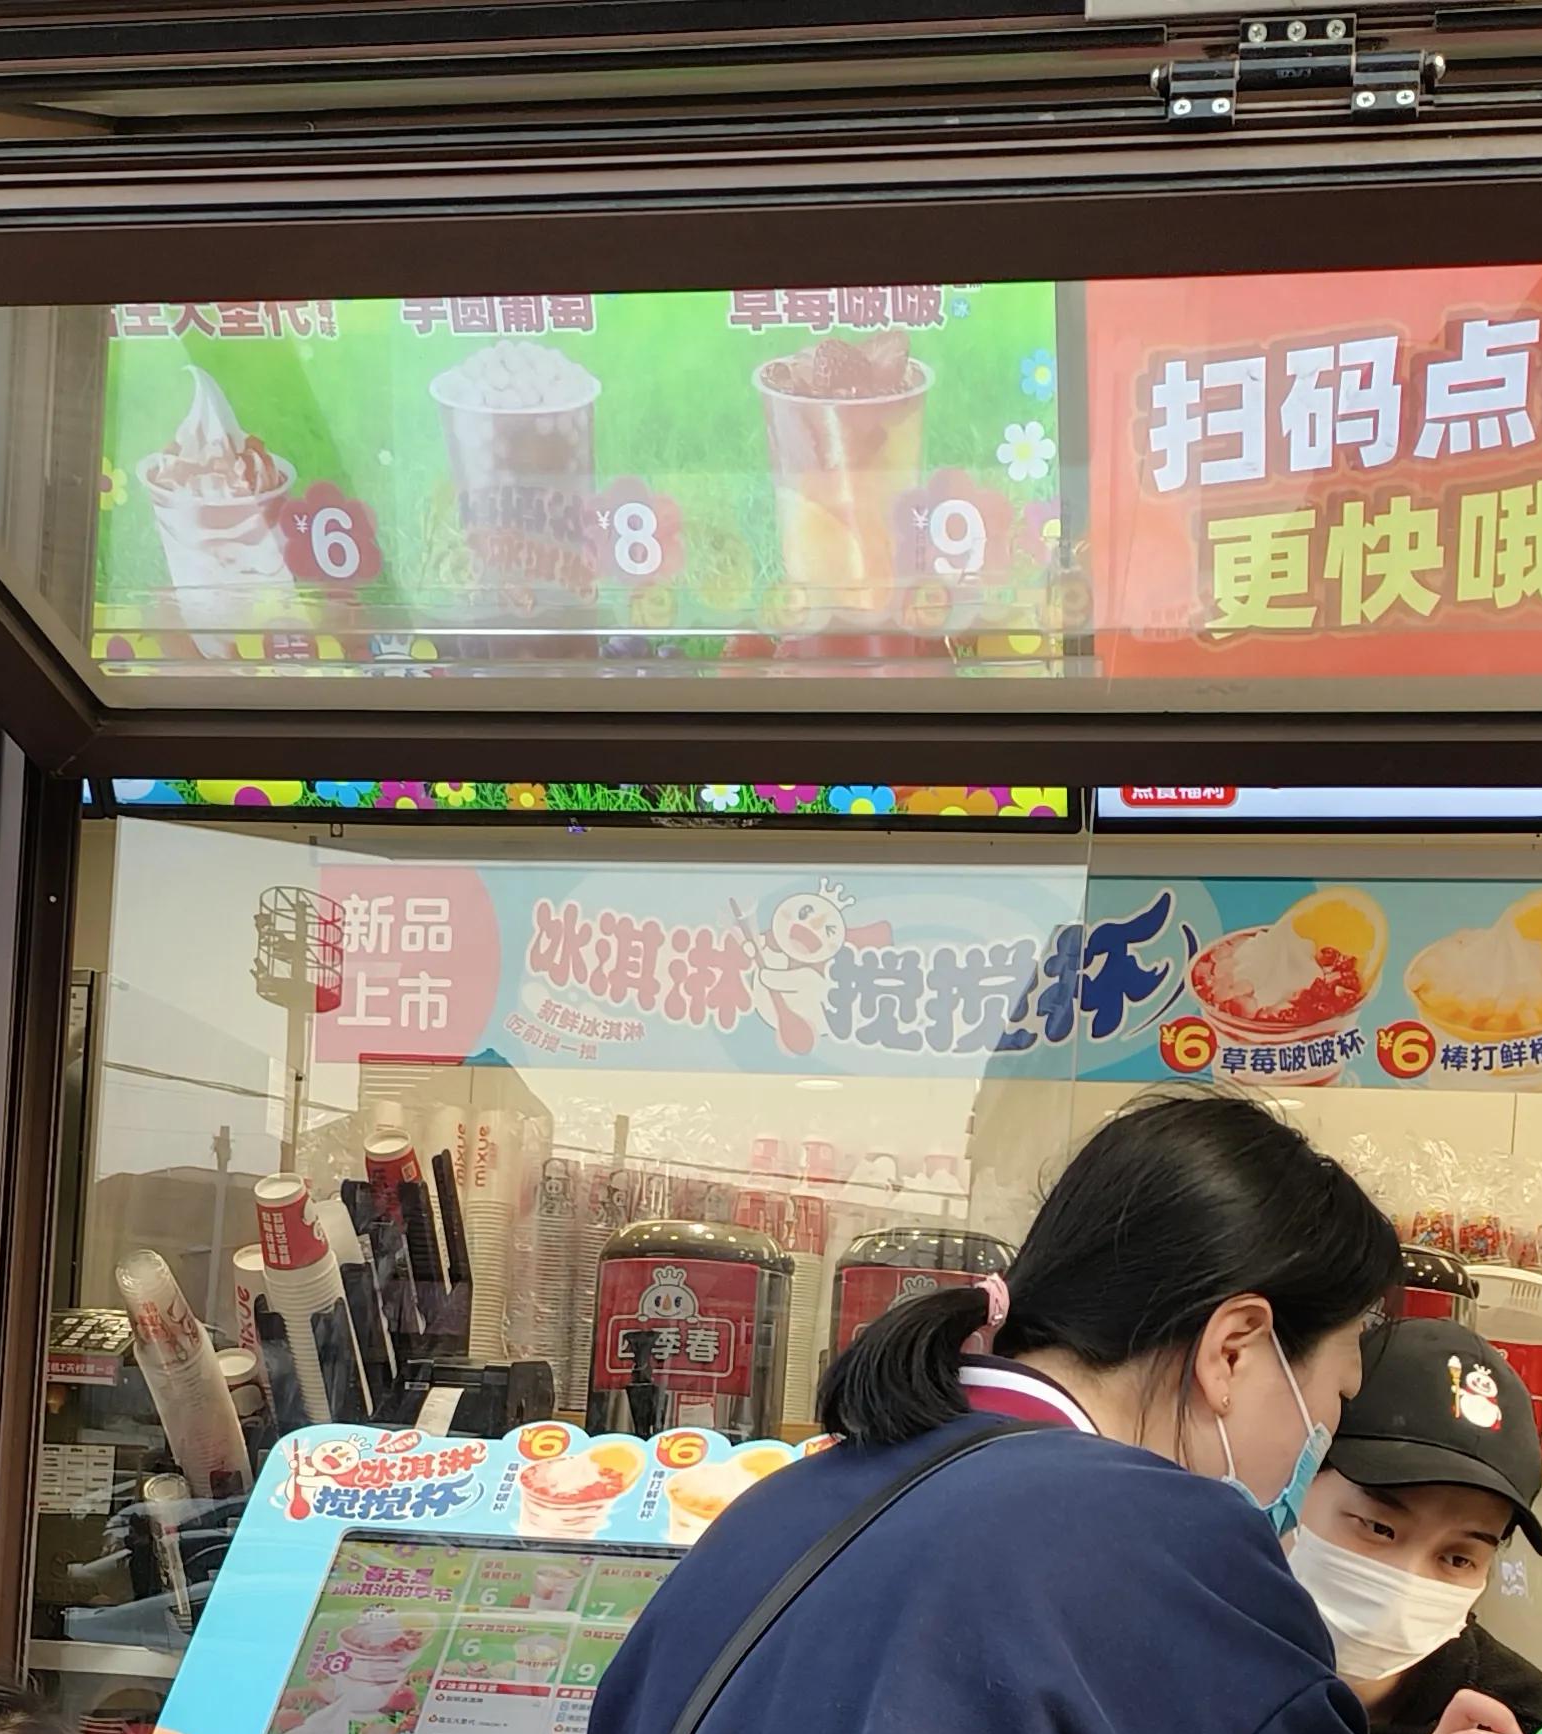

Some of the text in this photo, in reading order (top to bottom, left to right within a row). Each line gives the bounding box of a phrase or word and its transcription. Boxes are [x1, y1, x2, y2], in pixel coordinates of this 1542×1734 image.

[110, 303, 311, 337] 王大圣代
[342, 893, 454, 956] 新品
[529, 889, 1197, 1052] 冰淇淋 搅搅杯
[337, 970, 453, 1032] 上市
[537, 999, 646, 1041] 新鲜冰淇淋
[1220, 1027, 1366, 1074] 草莓啵啵杯
[475, 1125, 491, 1188] mixue
[356, 1441, 486, 1484] 冰淇淋
[384, 1432, 419, 1453] NEW
[314, 1474, 479, 1520] 搅搅杯
